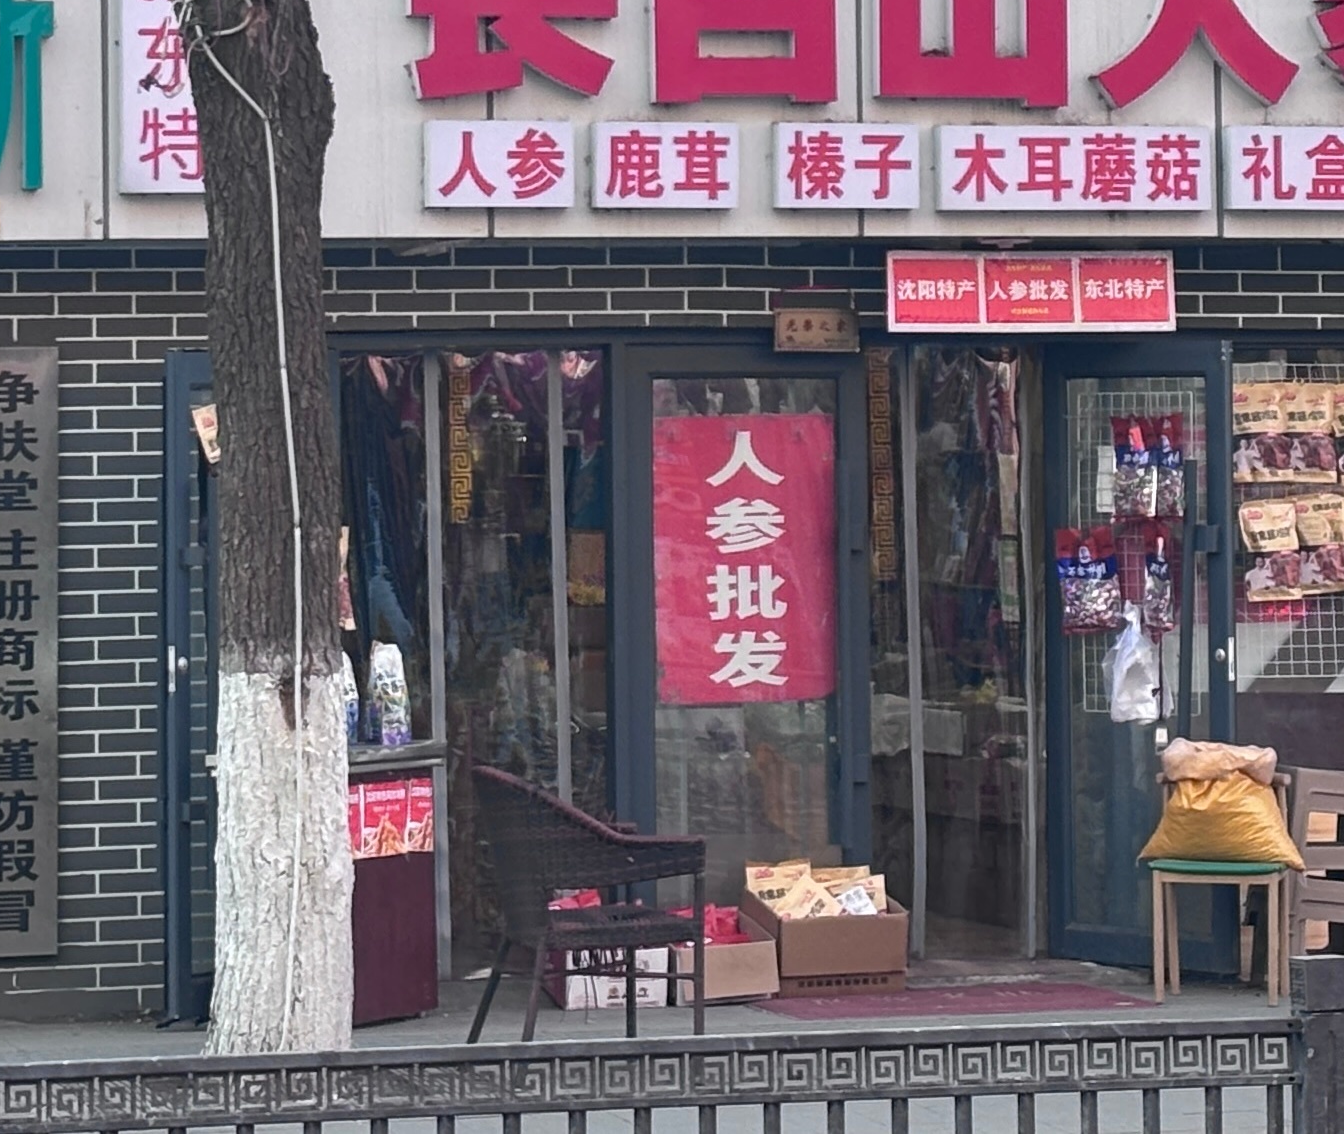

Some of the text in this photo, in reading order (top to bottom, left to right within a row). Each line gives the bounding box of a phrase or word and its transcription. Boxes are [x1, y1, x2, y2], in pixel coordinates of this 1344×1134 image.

[438, 129, 566, 200] 人参
[605, 130, 731, 201] 鹿茸
[787, 130, 912, 202] 榛子
[952, 132, 1202, 204] 木耳蘑菇
[896, 277, 1166, 302] 沈阳特产 人参批发 东北特产
[705, 430, 789, 688] 人参批发
